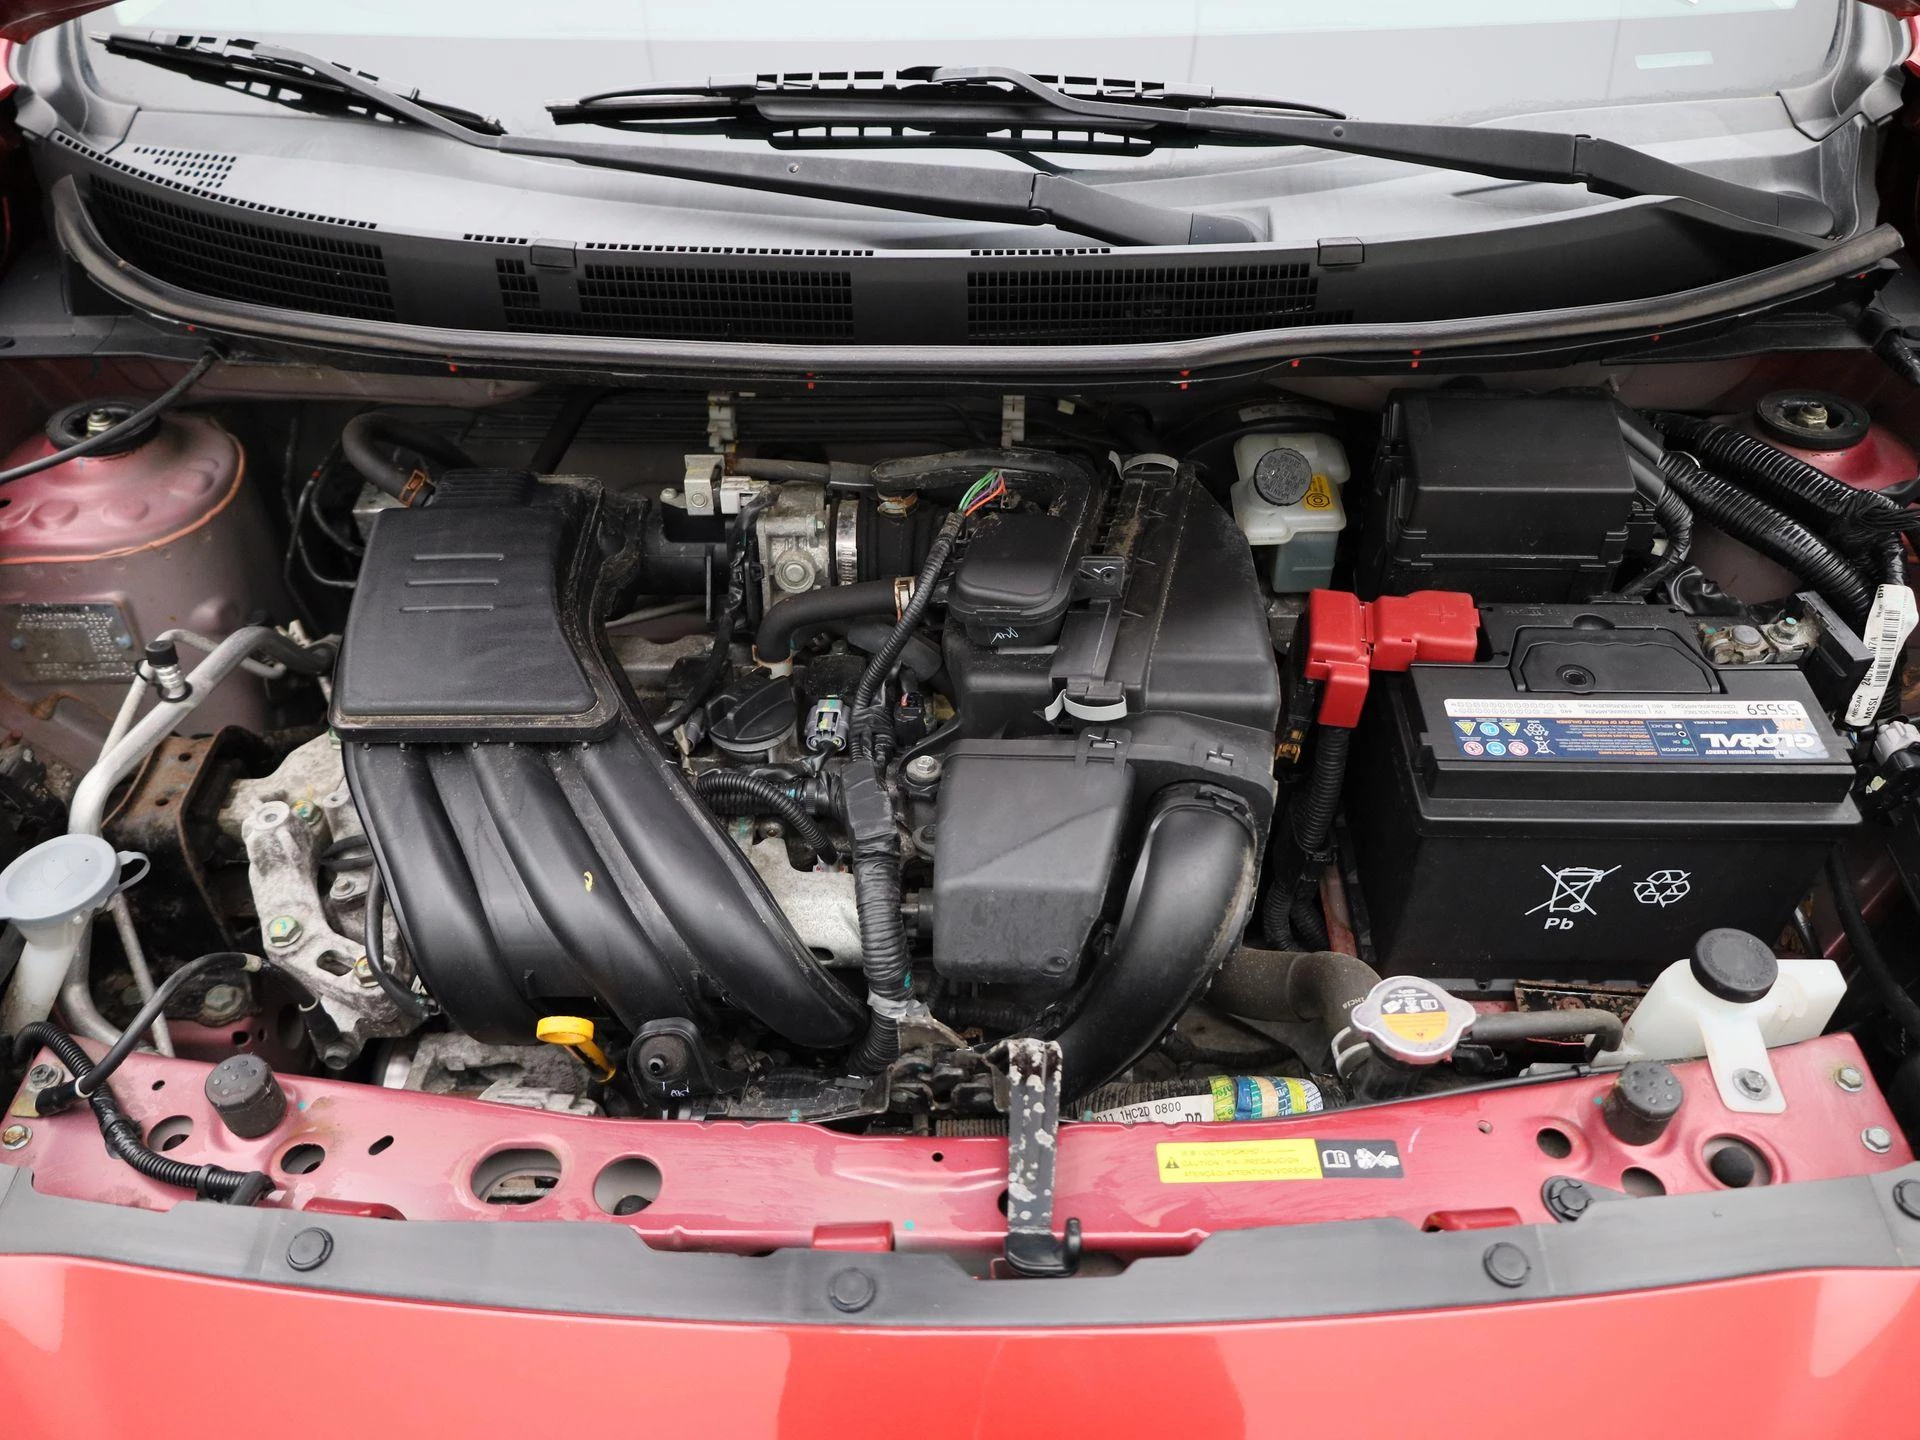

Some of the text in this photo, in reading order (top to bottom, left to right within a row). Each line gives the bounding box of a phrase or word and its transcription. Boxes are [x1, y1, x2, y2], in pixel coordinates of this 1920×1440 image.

[1851, 694, 1863, 718] NISSAN
[1863, 695, 1880, 720] MSSL
[1700, 733, 1816, 748] GLOBAL
[1543, 918, 1574, 930] Pb
[1154, 1101, 1182, 1115] 0800
